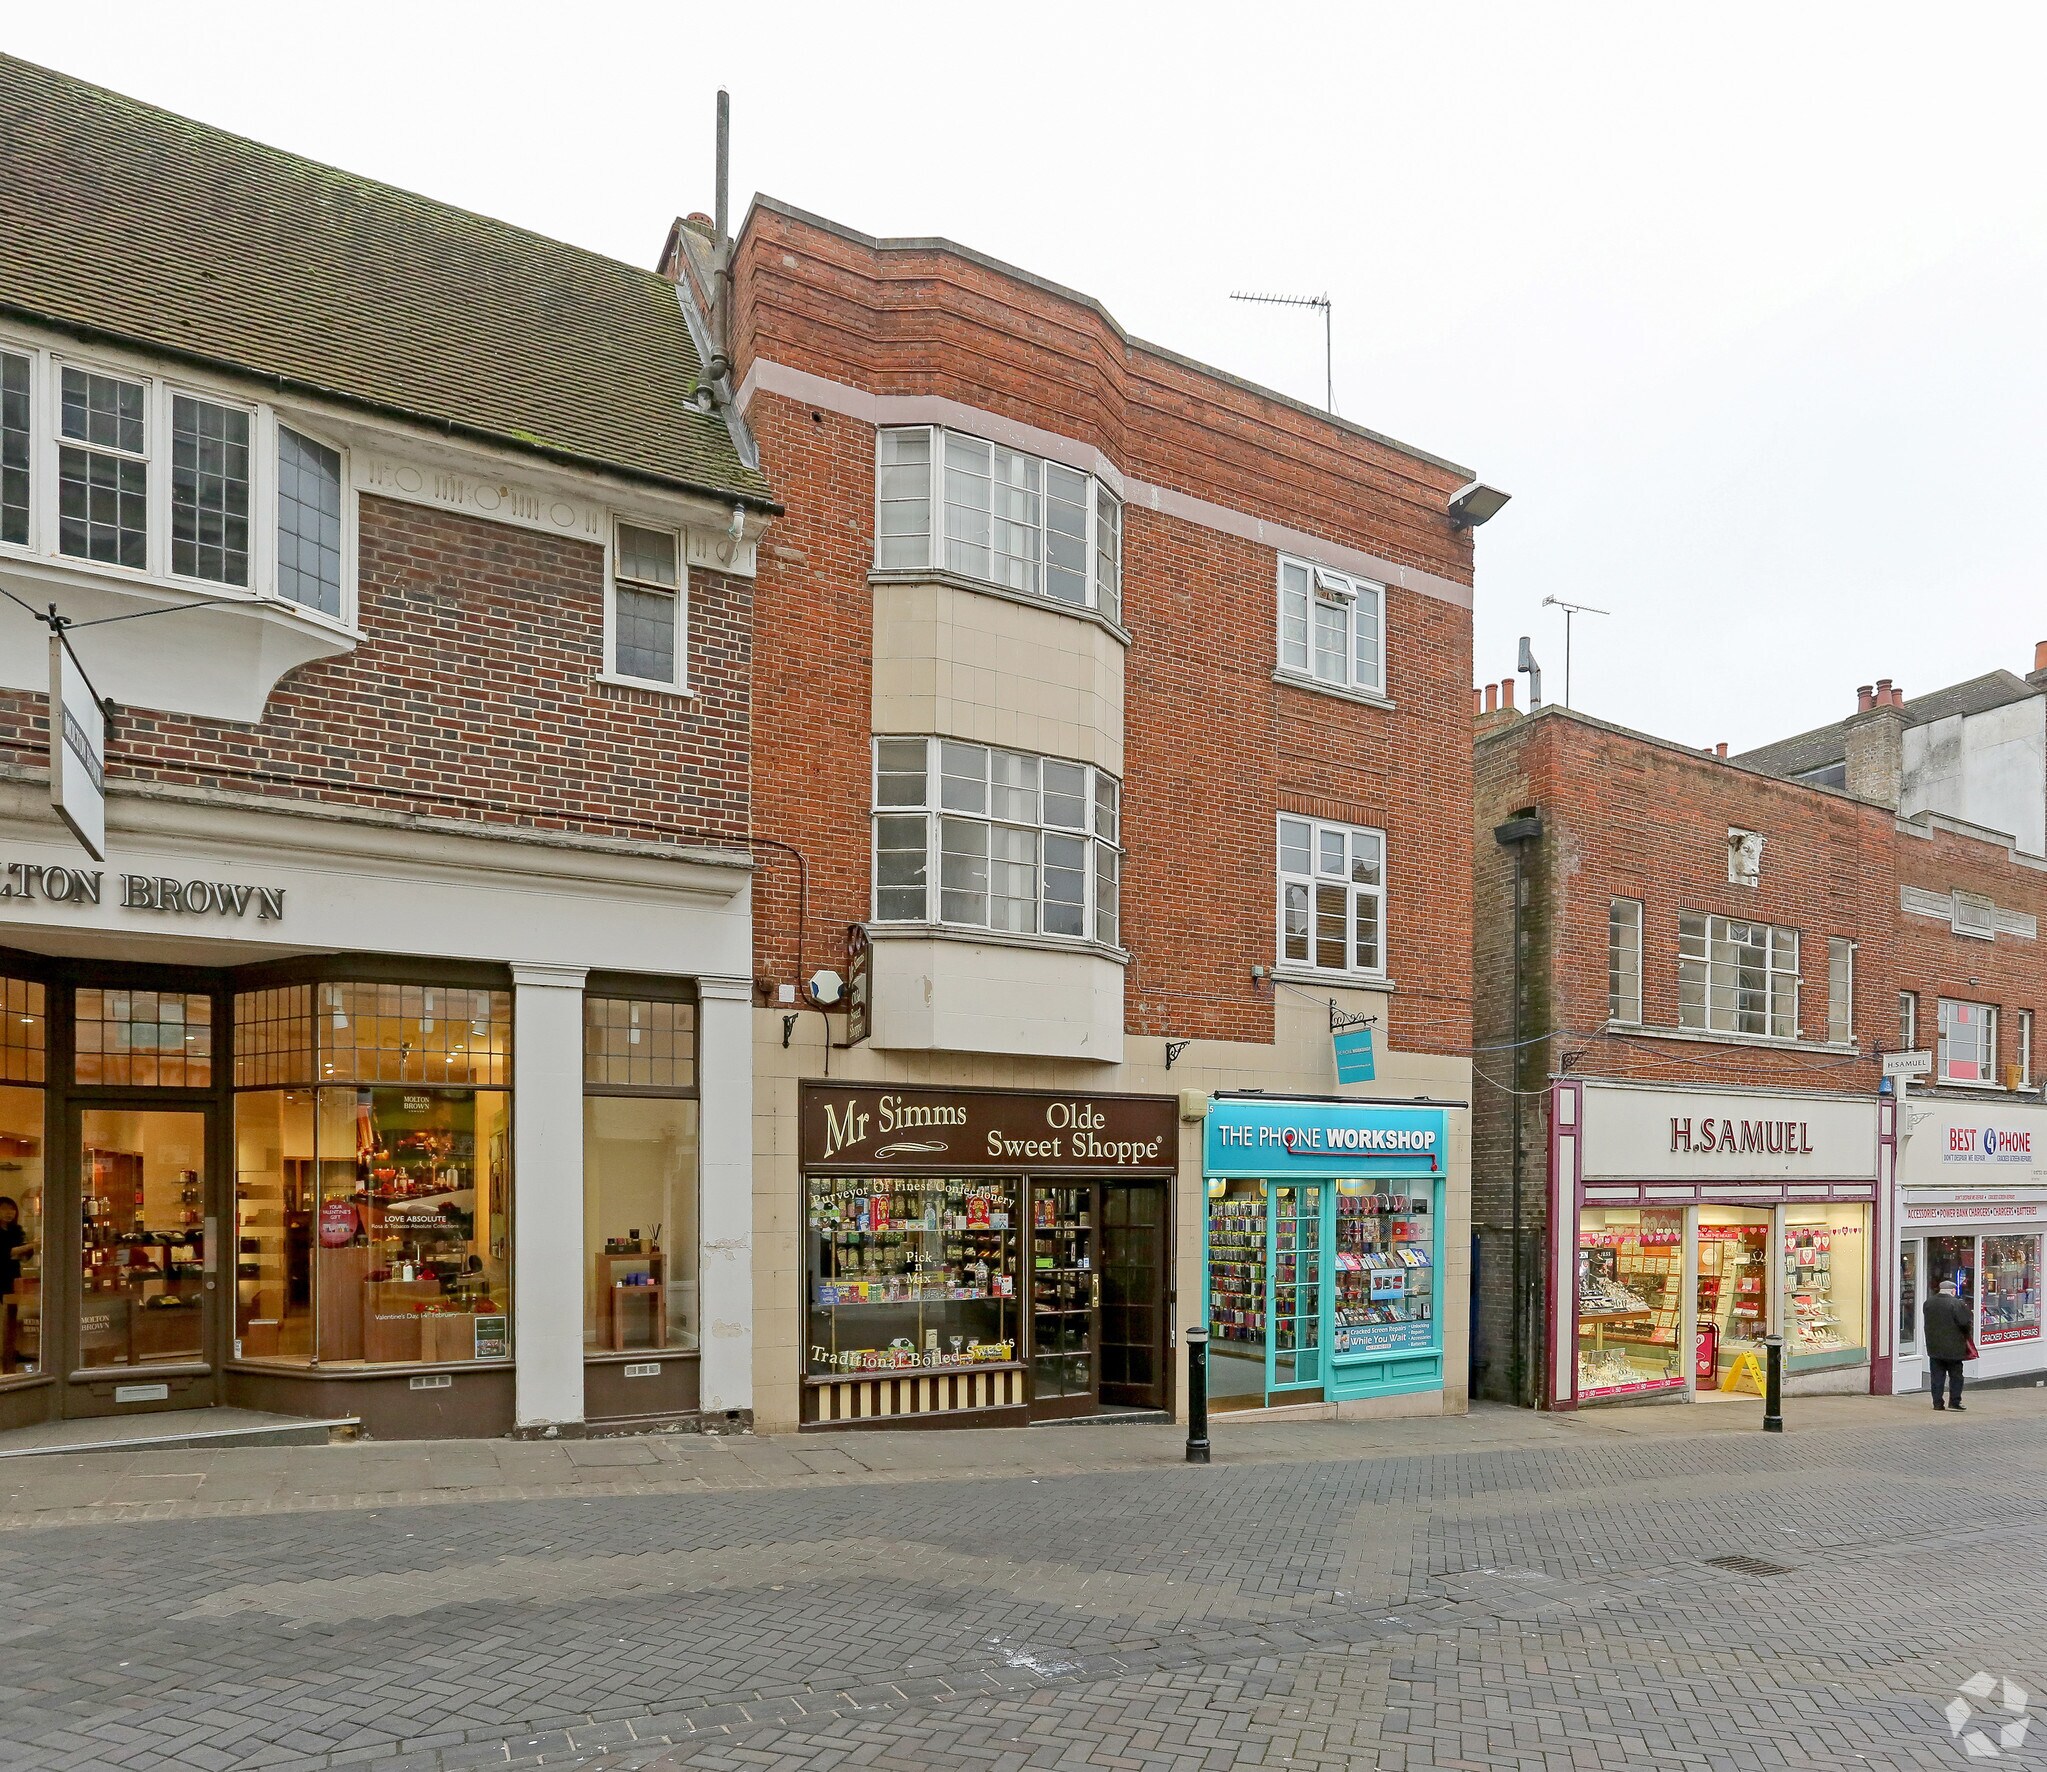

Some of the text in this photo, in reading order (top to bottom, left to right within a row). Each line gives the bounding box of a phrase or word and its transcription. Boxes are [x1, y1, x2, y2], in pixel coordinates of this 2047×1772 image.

[0, 861, 287, 921] TON BROWN
[1046, 1102, 1106, 1130] Olde
[823, 1095, 967, 1159] Mr Simms
[1219, 1125, 1436, 1150] THE PHONE WORKSHOP
[1670, 1117, 1814, 1154] H.SAMUEL
[1949, 1128, 2031, 1154] BEST 4 PHONE
[987, 1130, 1062, 1157] Sweet
[811, 1178, 1015, 1208] Purveyor Of Finest Confectionery
[1908, 1206, 2037, 1218] ACCESSORIES POWER BANK CHARGERS CHARGERS BATTERIES
[905, 1251, 932, 1263] Pick
[914, 1263, 922, 1271] n
[905, 1272, 931, 1284] Mix
[80, 1315, 110, 1324] MOLTON
[375, 1313, 406, 1321] Valentine's
[81, 1322, 110, 1331] BROWN
[1371, 1326, 1388, 1334] Screen
[1388, 1325, 1406, 1333] Repairs
[1350, 1333, 1407, 1345] While You Wait
[2003, 1330, 2020, 1340] SCREEN
[811, 1338, 1015, 1369] Traditional Boiled Sweets
